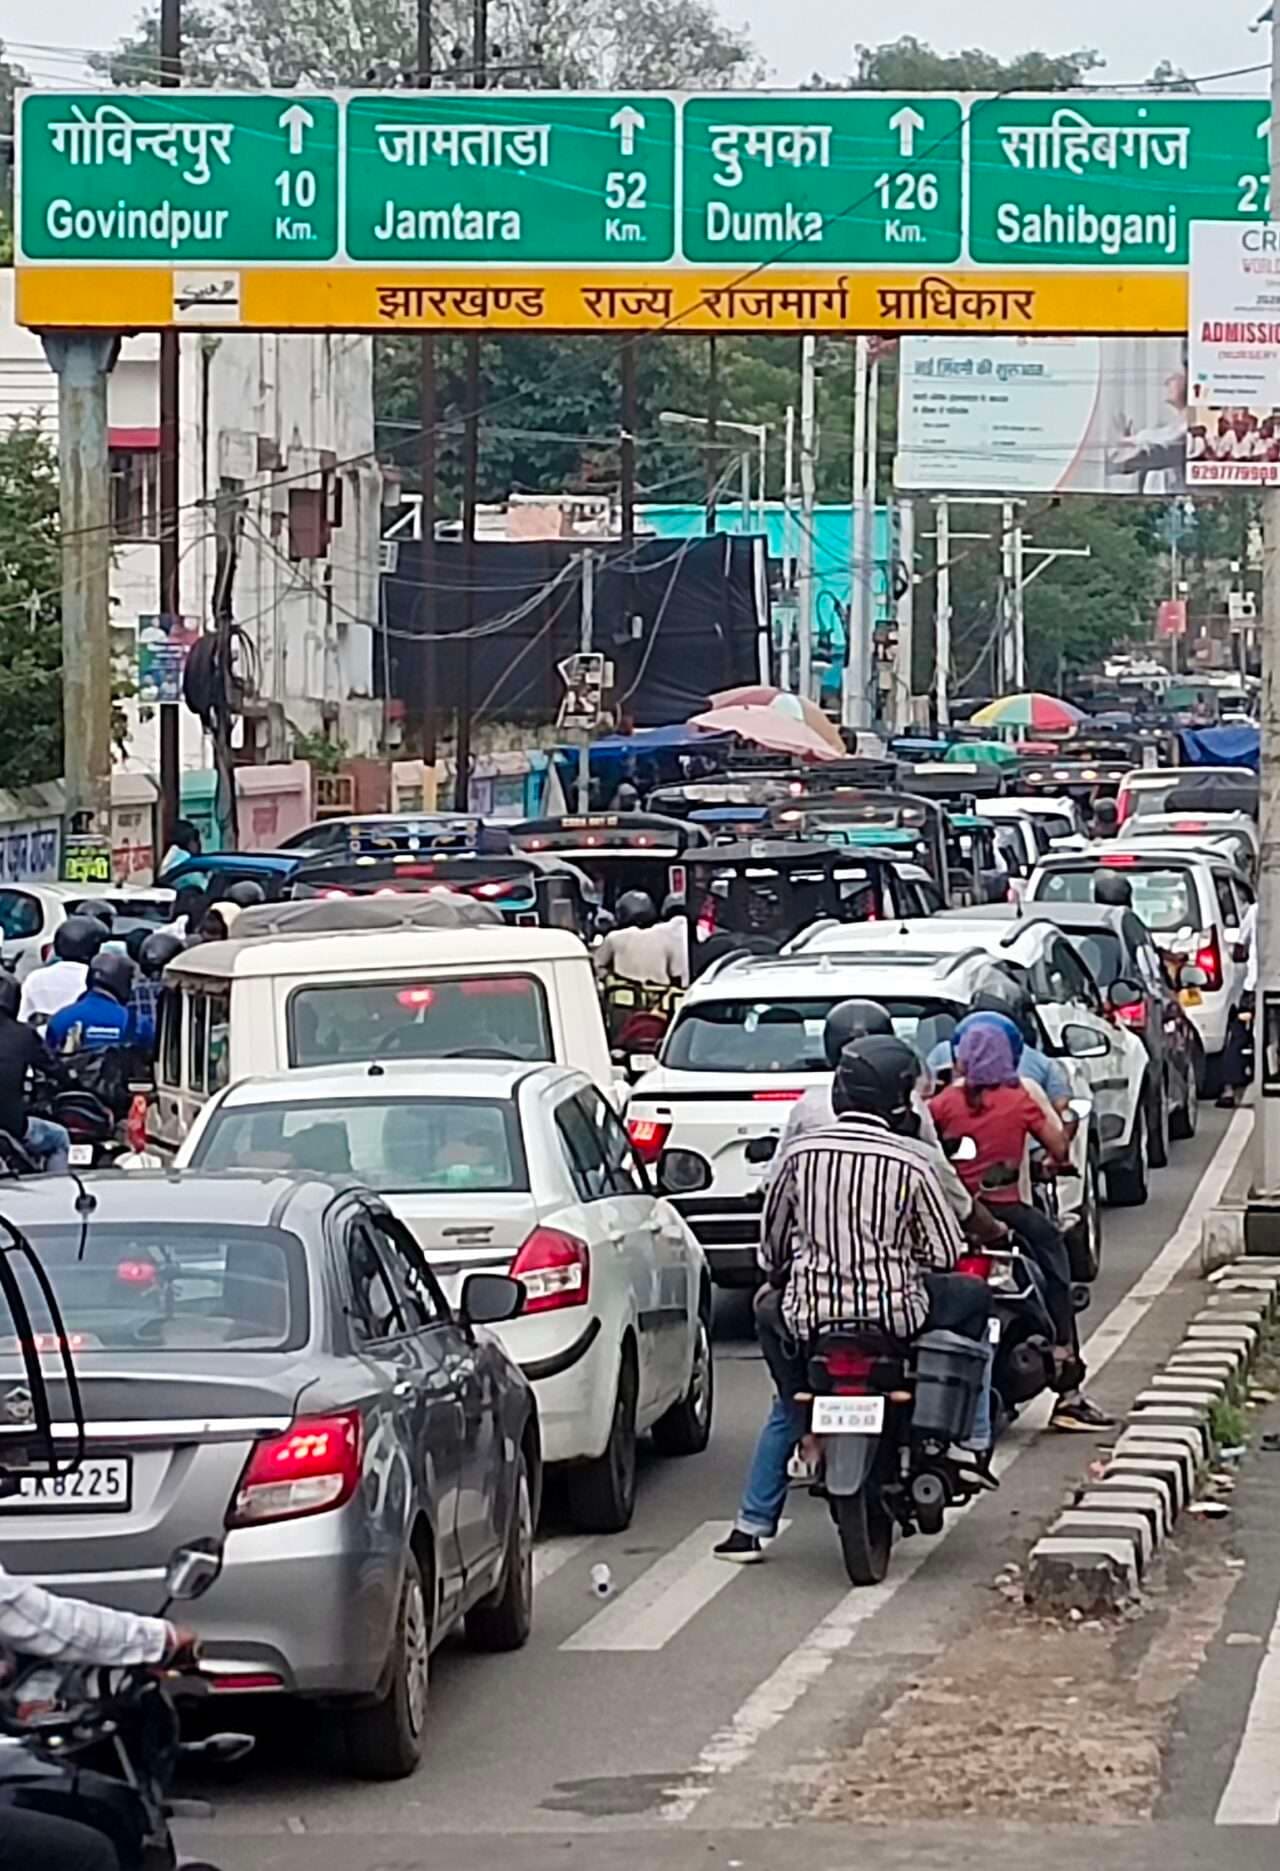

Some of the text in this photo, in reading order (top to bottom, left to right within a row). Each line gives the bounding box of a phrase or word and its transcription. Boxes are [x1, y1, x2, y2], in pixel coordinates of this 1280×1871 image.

[48, 106, 234, 184] गोविन्दपुर
[708, 125, 832, 186] दुमका
[998, 108, 1190, 173] साहिबगंज
[275, 171, 316, 208] 10
[604, 172, 647, 209] 52
[874, 173, 938, 210] 126
[47, 199, 228, 249] Govindpur
[276, 218, 317, 241] Km.
[374, 201, 520, 241] Jamtara
[605, 218, 647, 242] Km.
[707, 201, 823, 241] Dumka
[884, 219, 926, 243] Km.
[997, 203, 1176, 255] Sahibganj
[377, 277, 1034, 320] झारखण्ड राज्य राजमार्ग प्राधिकार
